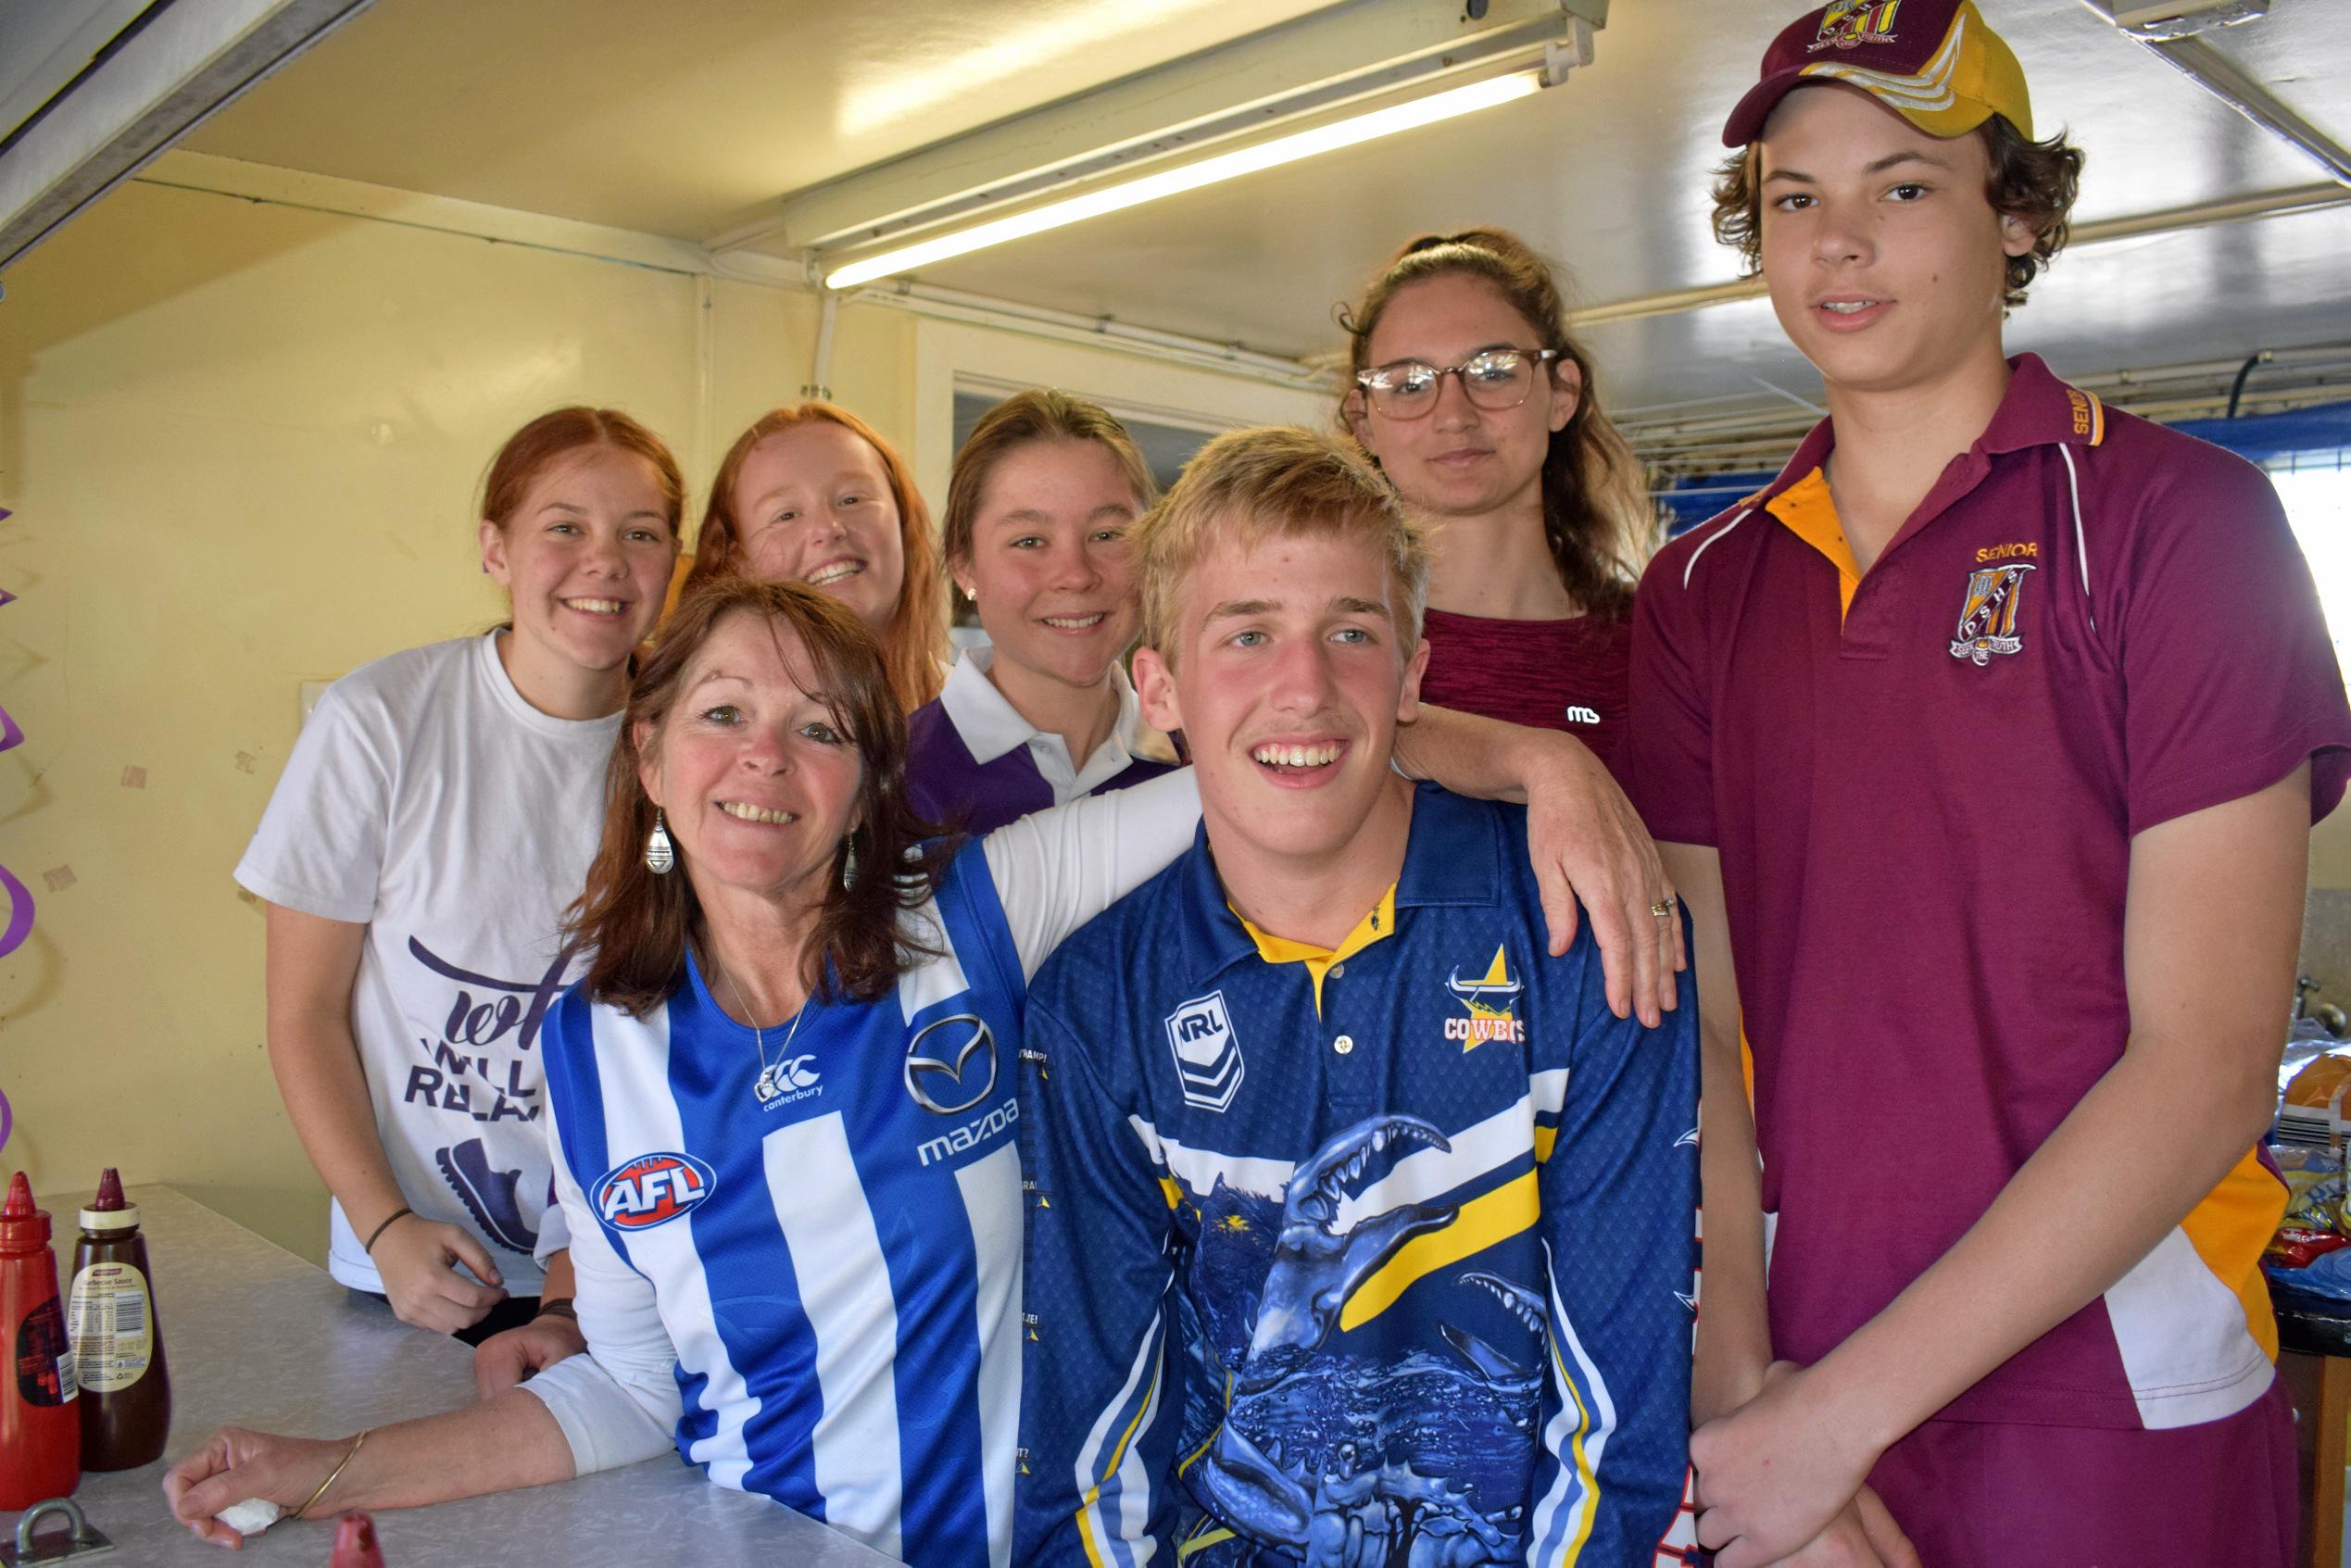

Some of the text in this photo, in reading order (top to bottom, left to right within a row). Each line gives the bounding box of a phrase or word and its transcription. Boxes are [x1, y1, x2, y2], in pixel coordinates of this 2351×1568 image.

[1975, 542, 2039, 562] SENIOR
[1177, 1009, 1224, 1043] NRL
[1444, 1018, 1526, 1041] COWBS
[404, 1064, 539, 1122] RELA
[762, 1085, 823, 1112] canterbury
[604, 1166, 706, 1221] AFL
